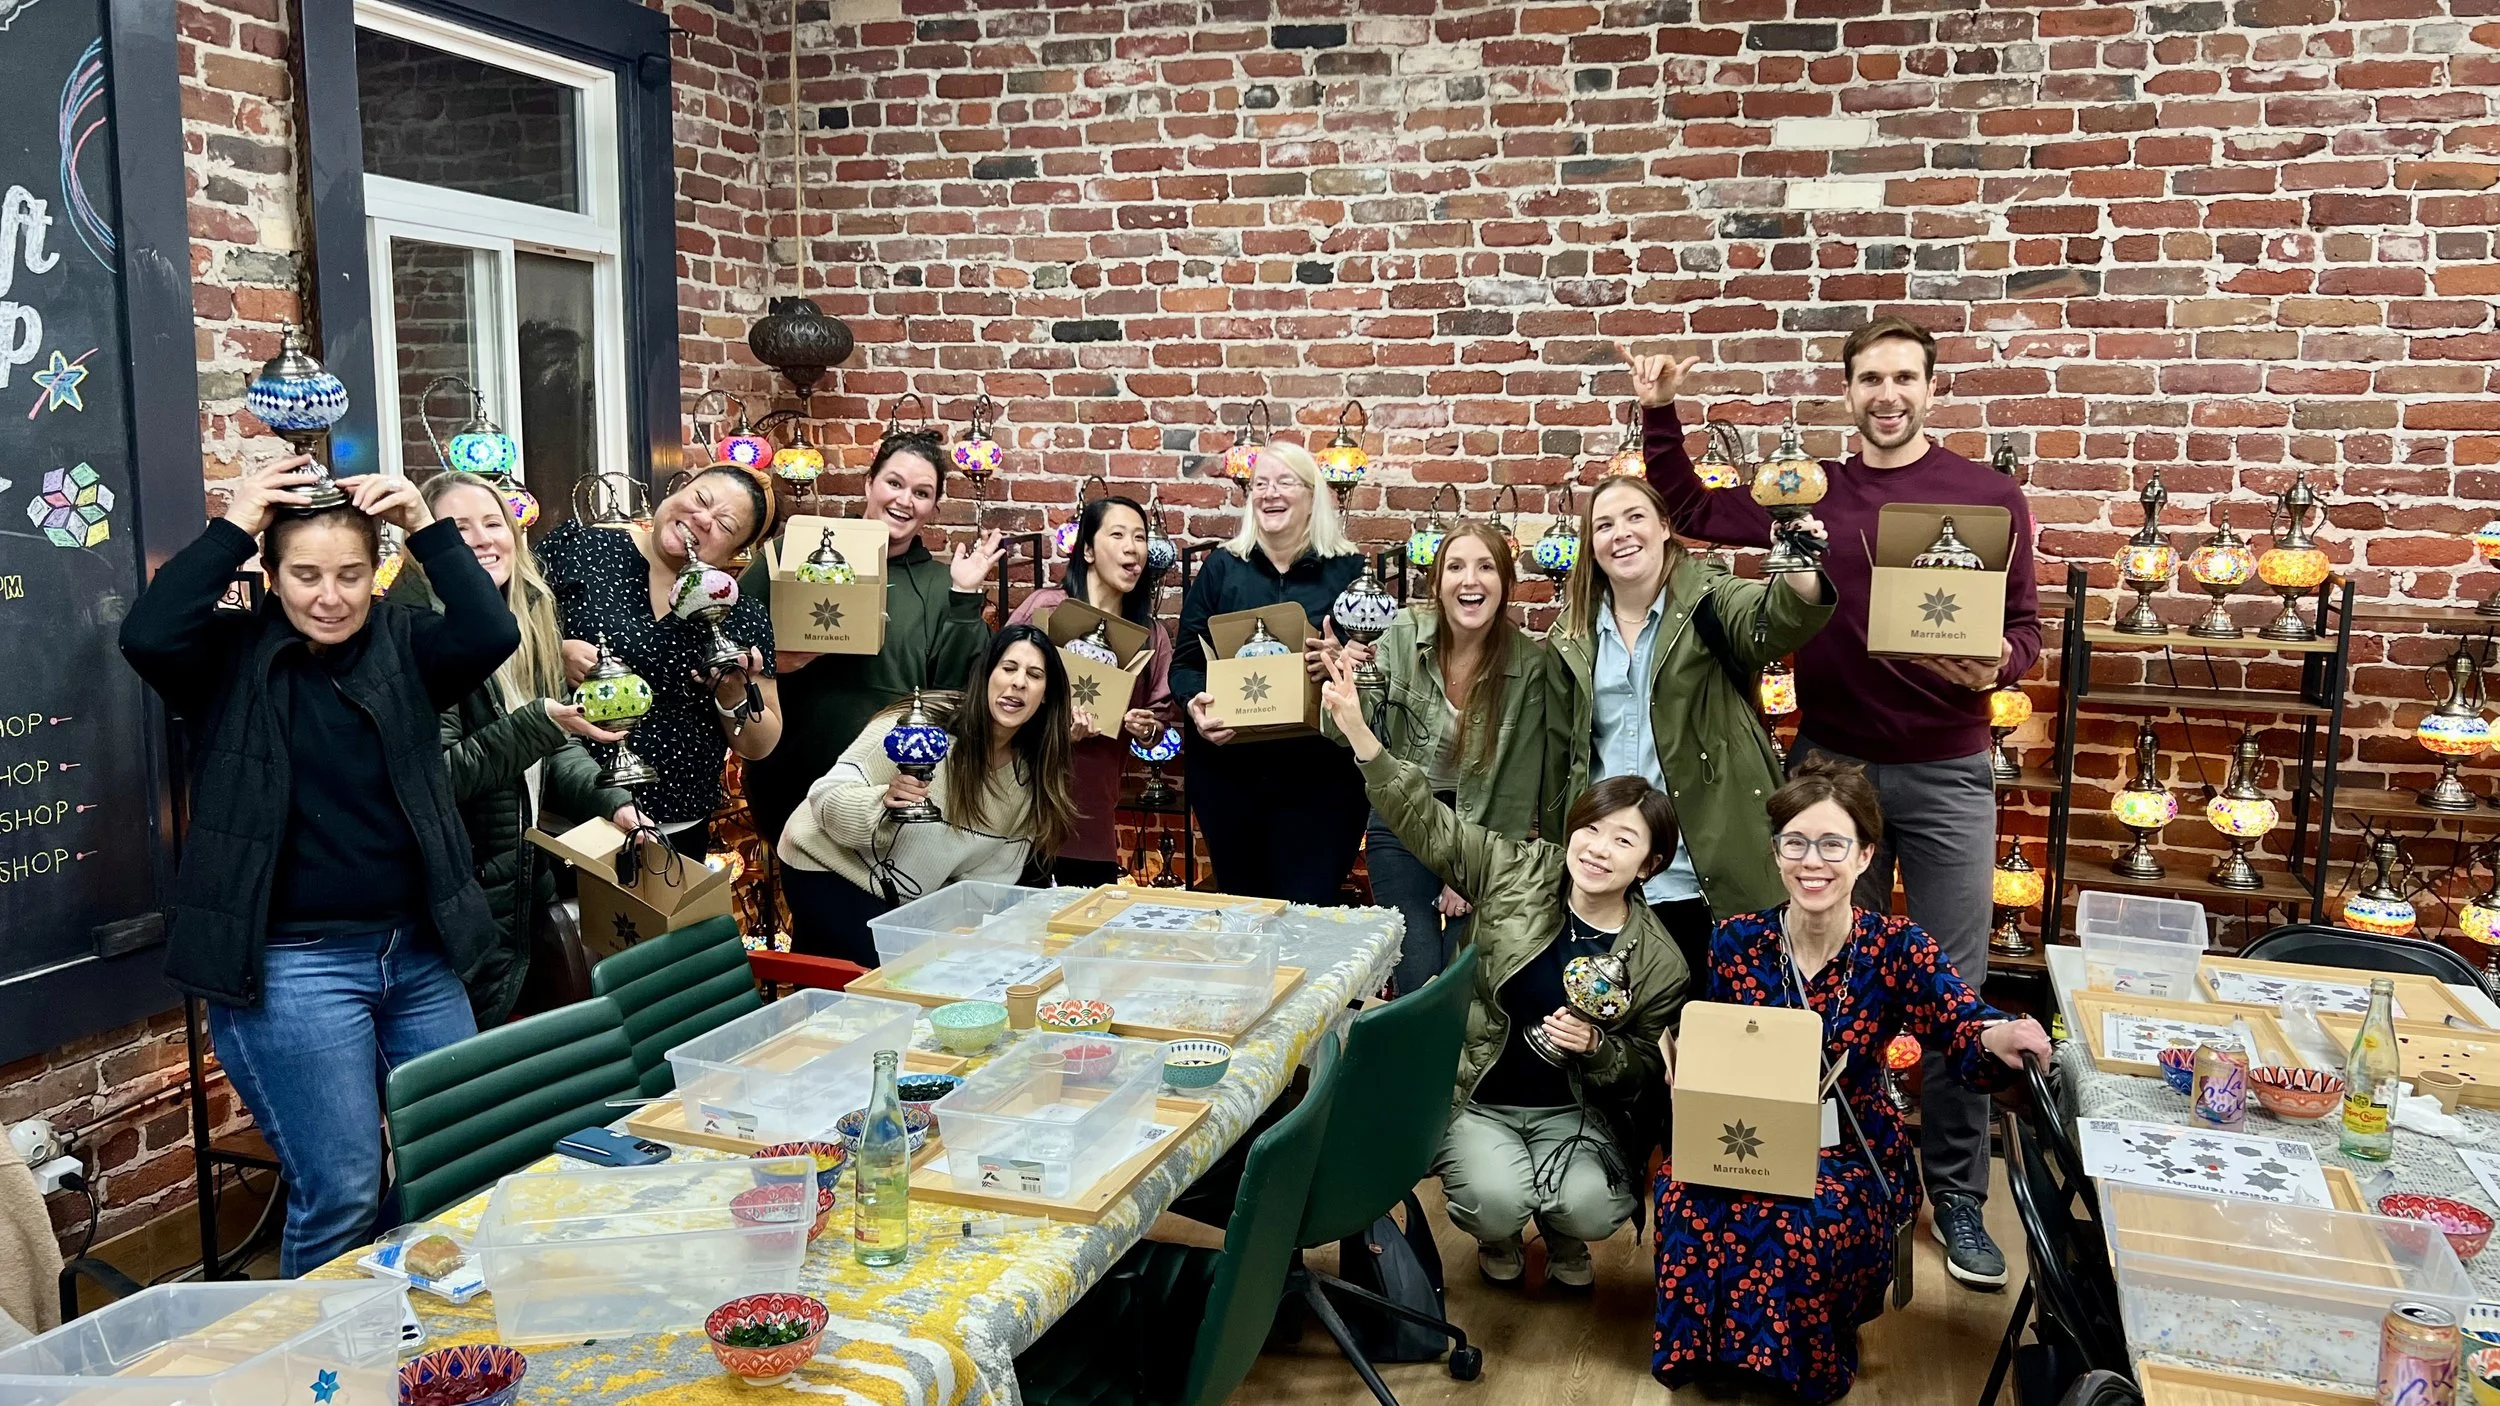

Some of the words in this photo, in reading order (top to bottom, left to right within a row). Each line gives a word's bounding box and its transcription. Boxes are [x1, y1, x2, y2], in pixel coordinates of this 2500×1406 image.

[0, 575, 24, 600] M
[804, 633, 850, 641] Marrakech
[1910, 629, 1967, 639] Marrakech
[1235, 704, 1277, 715] Marrakech
[1713, 1164, 1770, 1176] Marrakech
[2156, 1177, 2227, 1195] TEMPLATE
